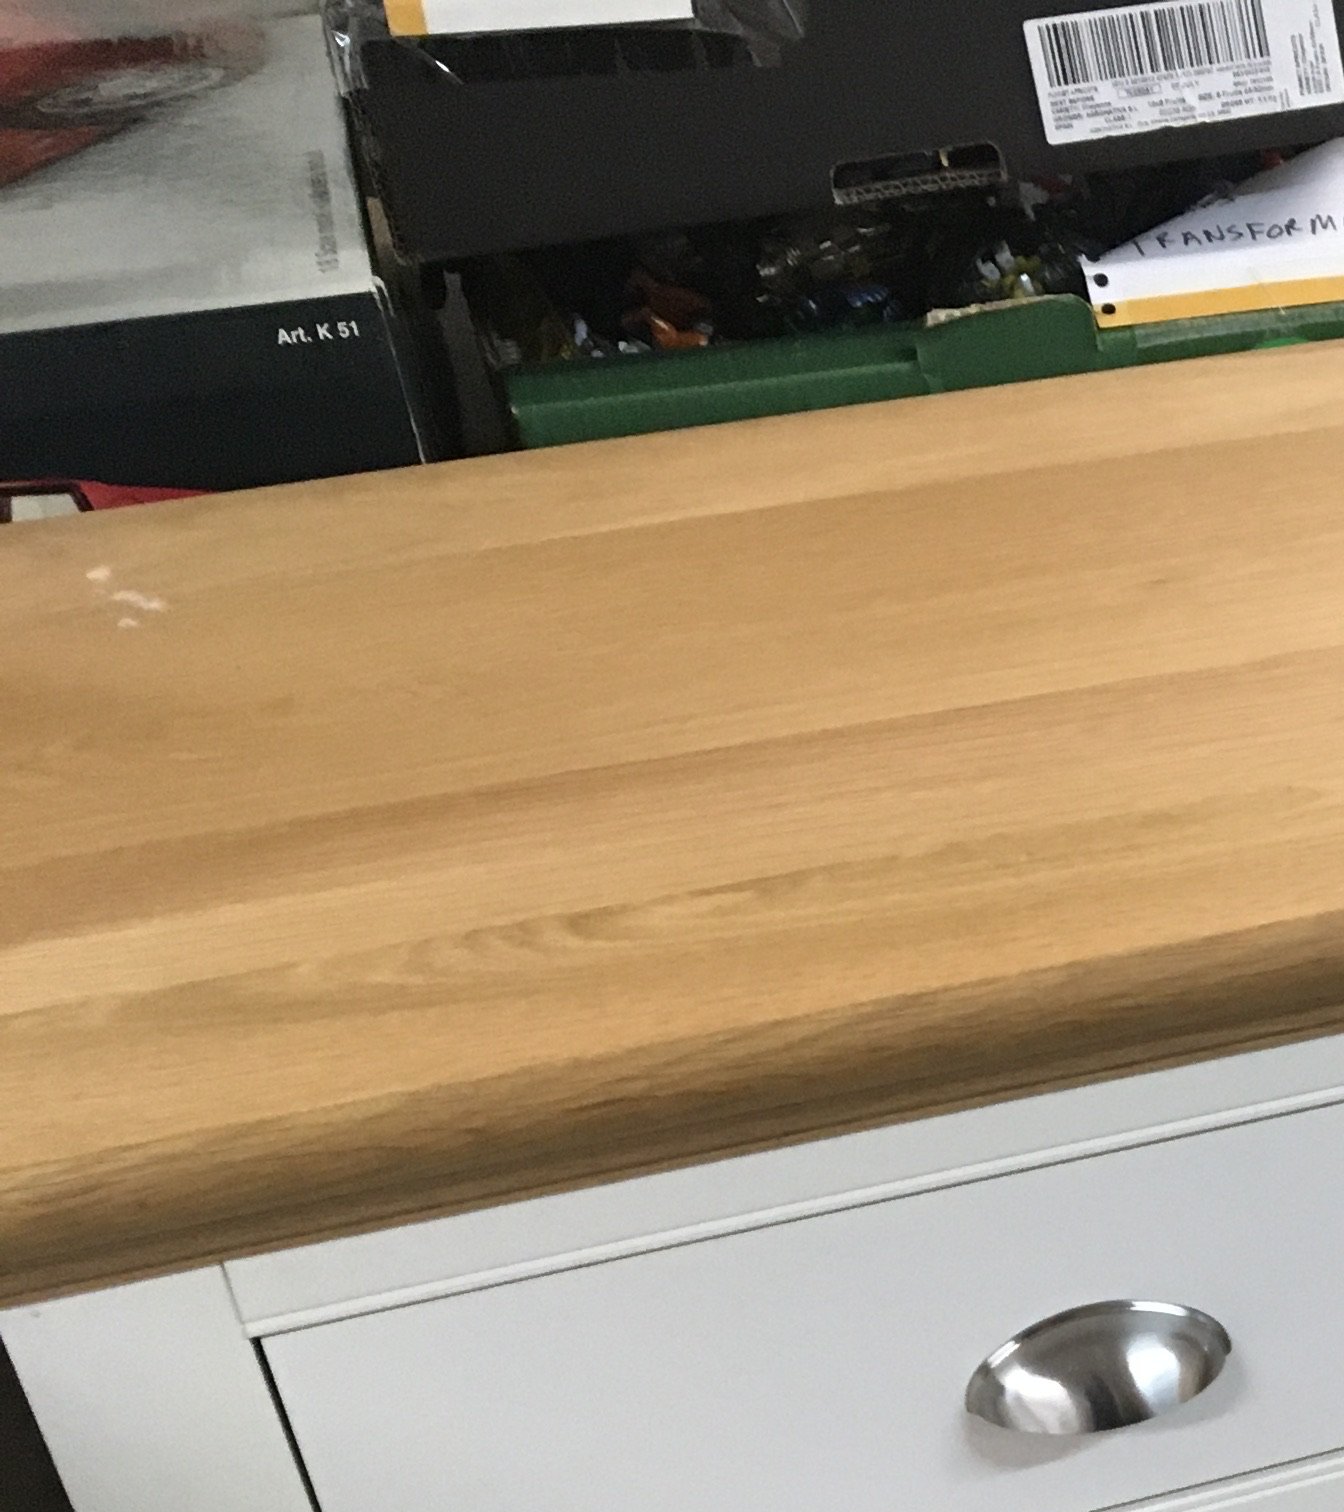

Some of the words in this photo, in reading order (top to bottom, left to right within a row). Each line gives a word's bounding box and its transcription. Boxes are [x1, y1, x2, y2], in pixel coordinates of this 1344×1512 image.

[277, 326, 313, 345] Art.
[315, 322, 334, 340] K
[337, 320, 360, 339] 51
